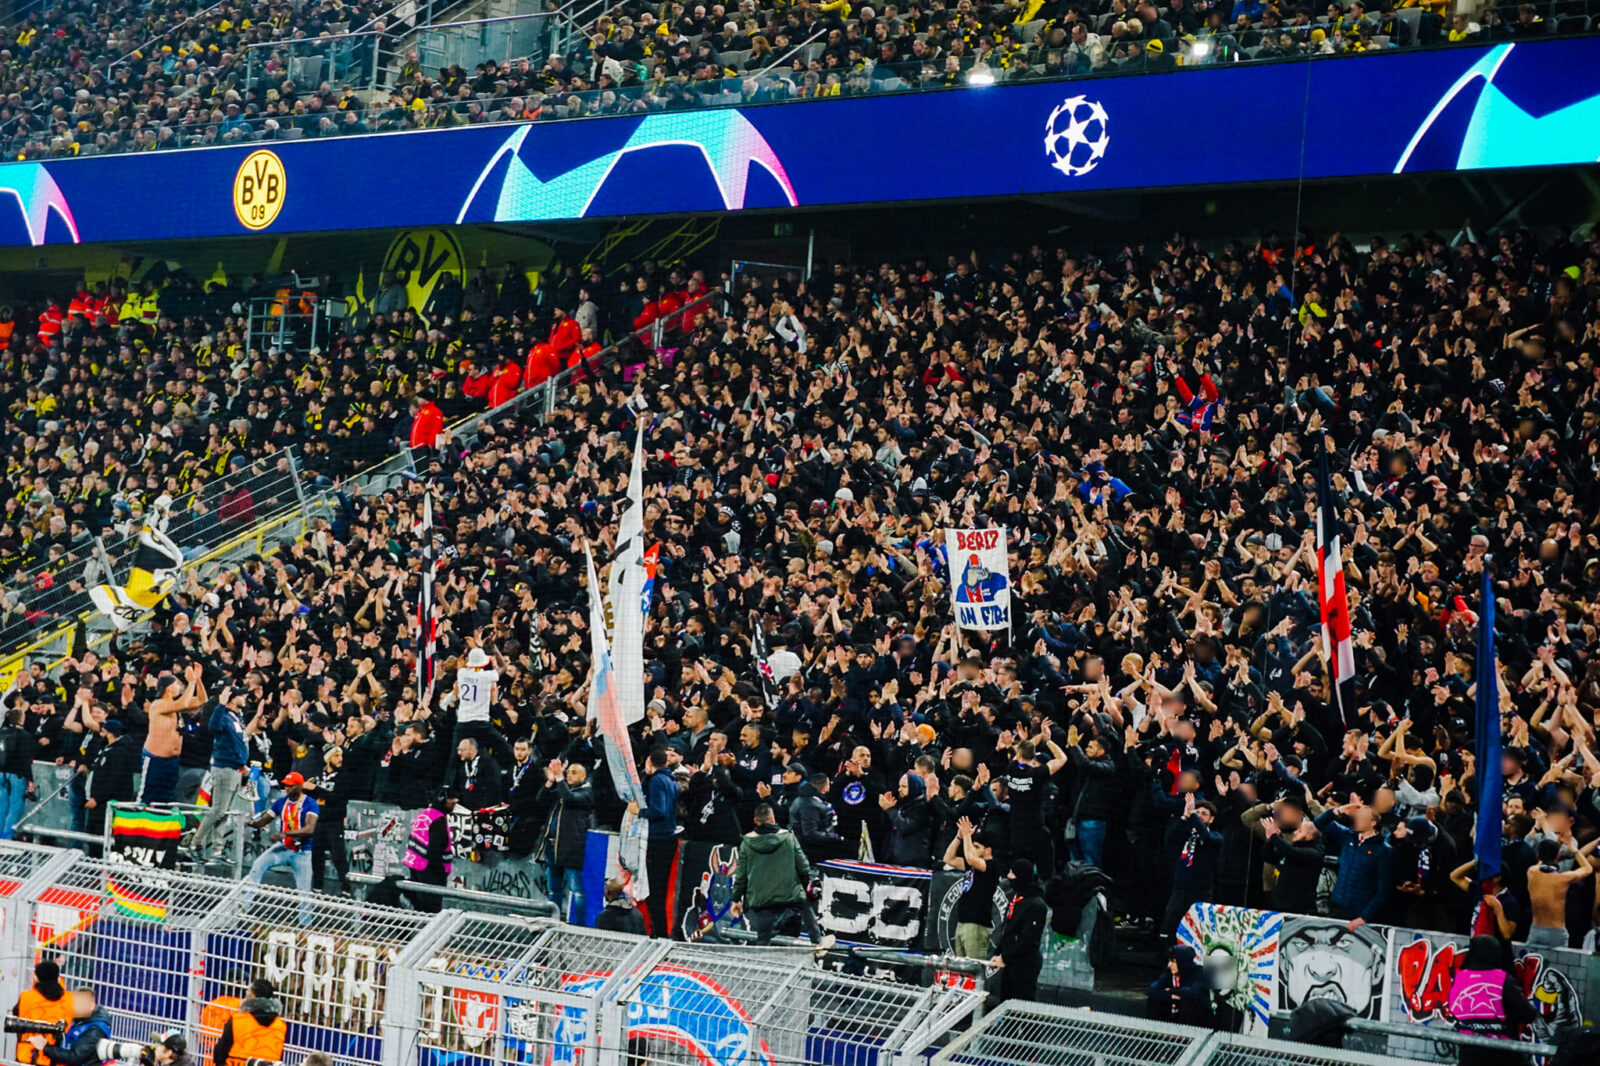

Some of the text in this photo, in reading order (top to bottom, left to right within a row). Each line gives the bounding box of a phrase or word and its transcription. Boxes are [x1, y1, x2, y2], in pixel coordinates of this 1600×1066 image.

[242, 159, 280, 205] BVB
[251, 204, 265, 220] 09
[960, 606, 978, 626] ON
[460, 683, 478, 703] 21
